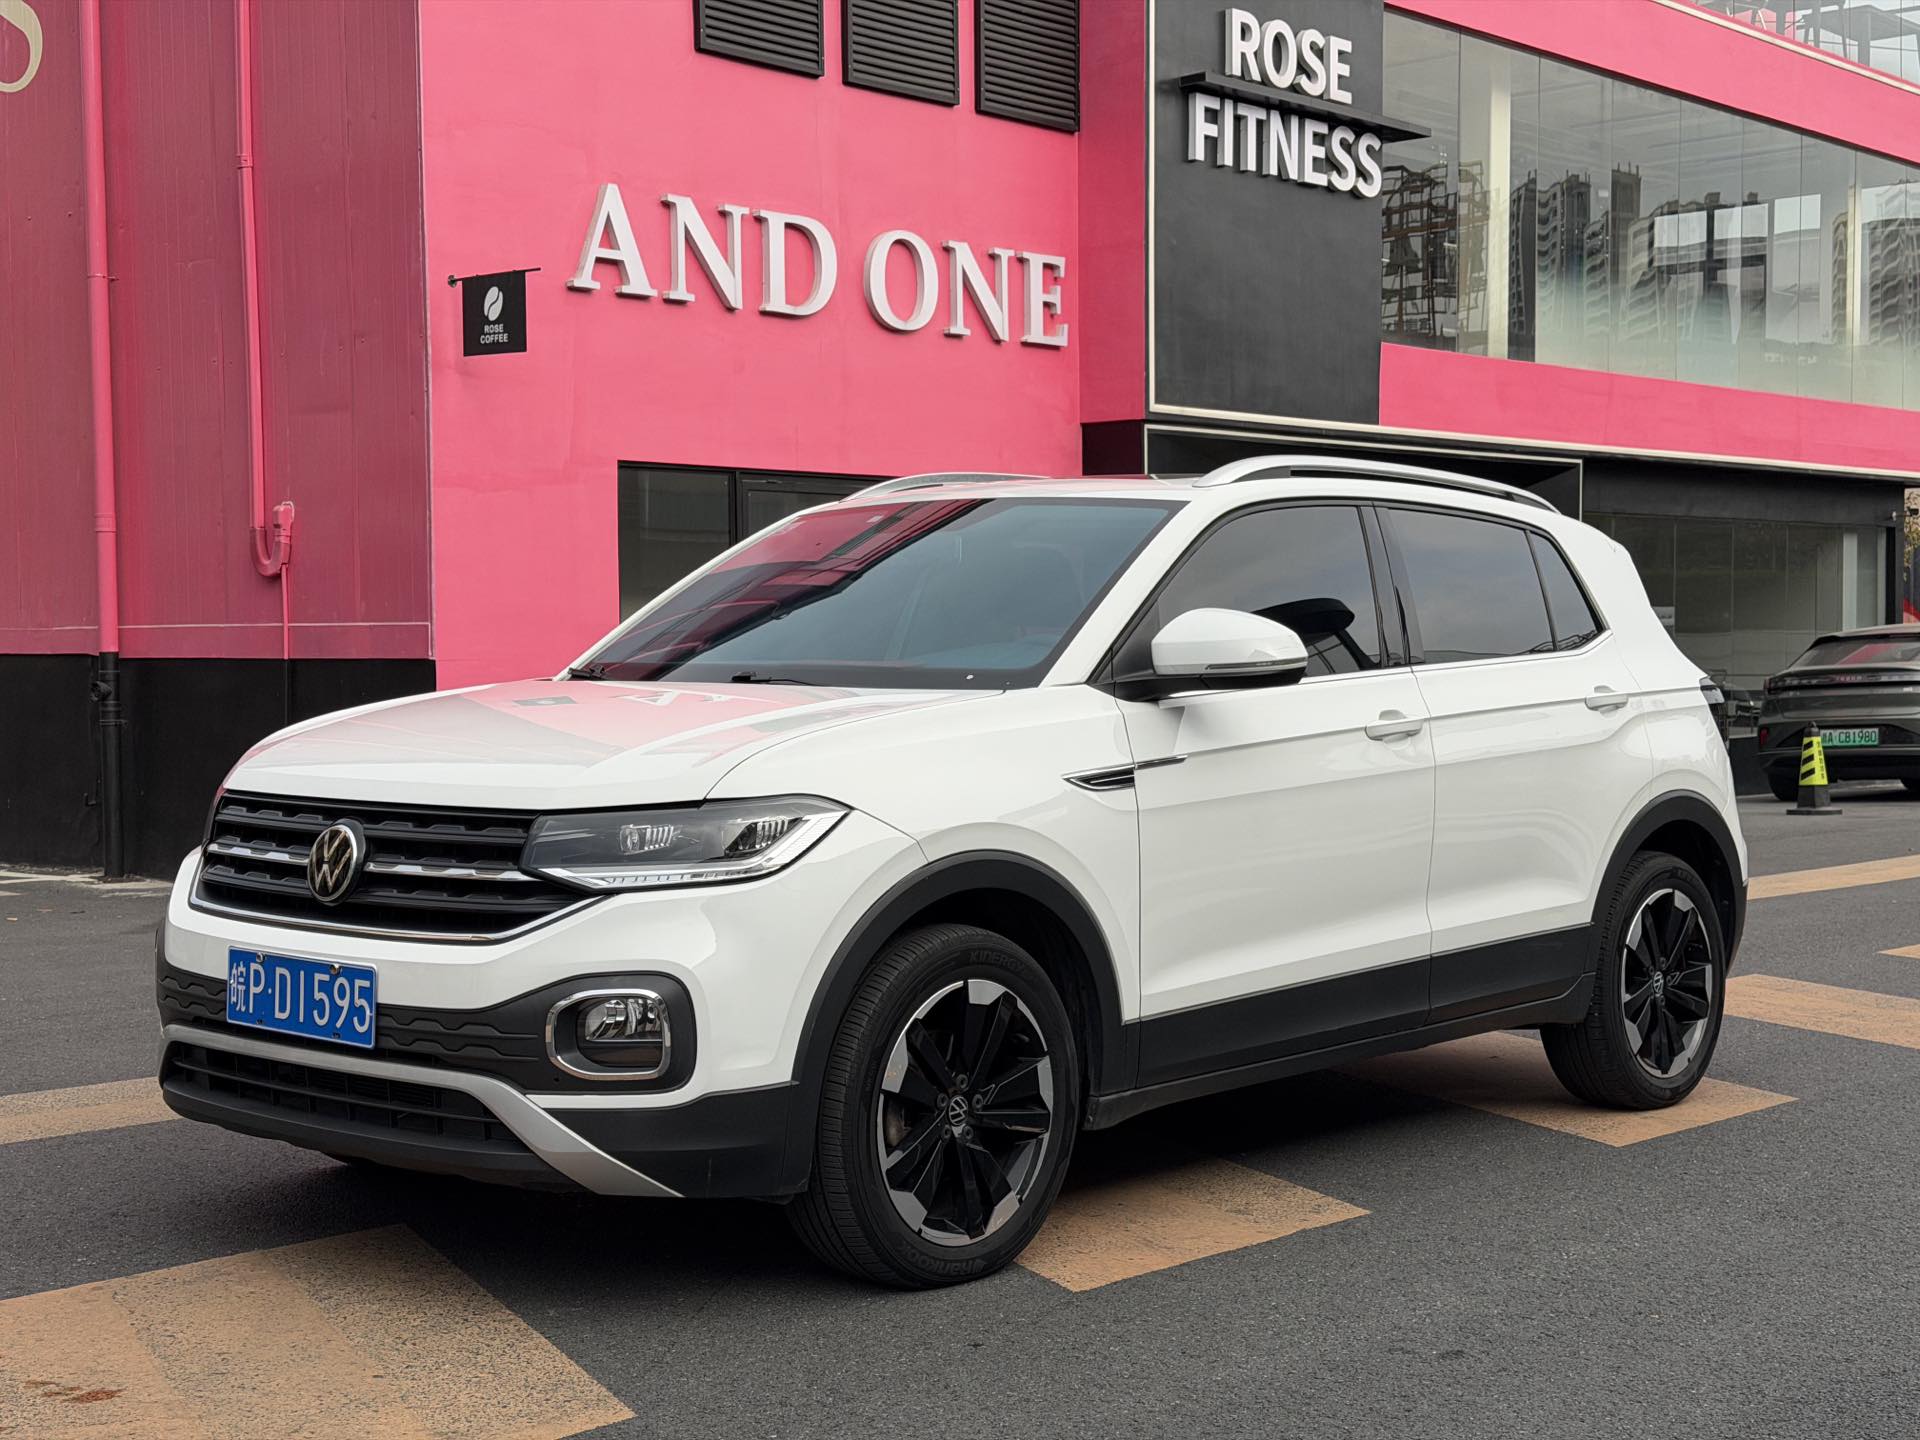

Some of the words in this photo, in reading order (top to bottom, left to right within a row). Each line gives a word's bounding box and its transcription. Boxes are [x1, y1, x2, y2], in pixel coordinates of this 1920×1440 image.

[1225, 8, 1353, 105] ROSE
[1188, 92, 1383, 198] FITNESS
[566, 183, 838, 317] AND
[864, 229, 1069, 348] ONE
[480, 333, 509, 344] COFFEE
[484, 323, 504, 333] ROSE
